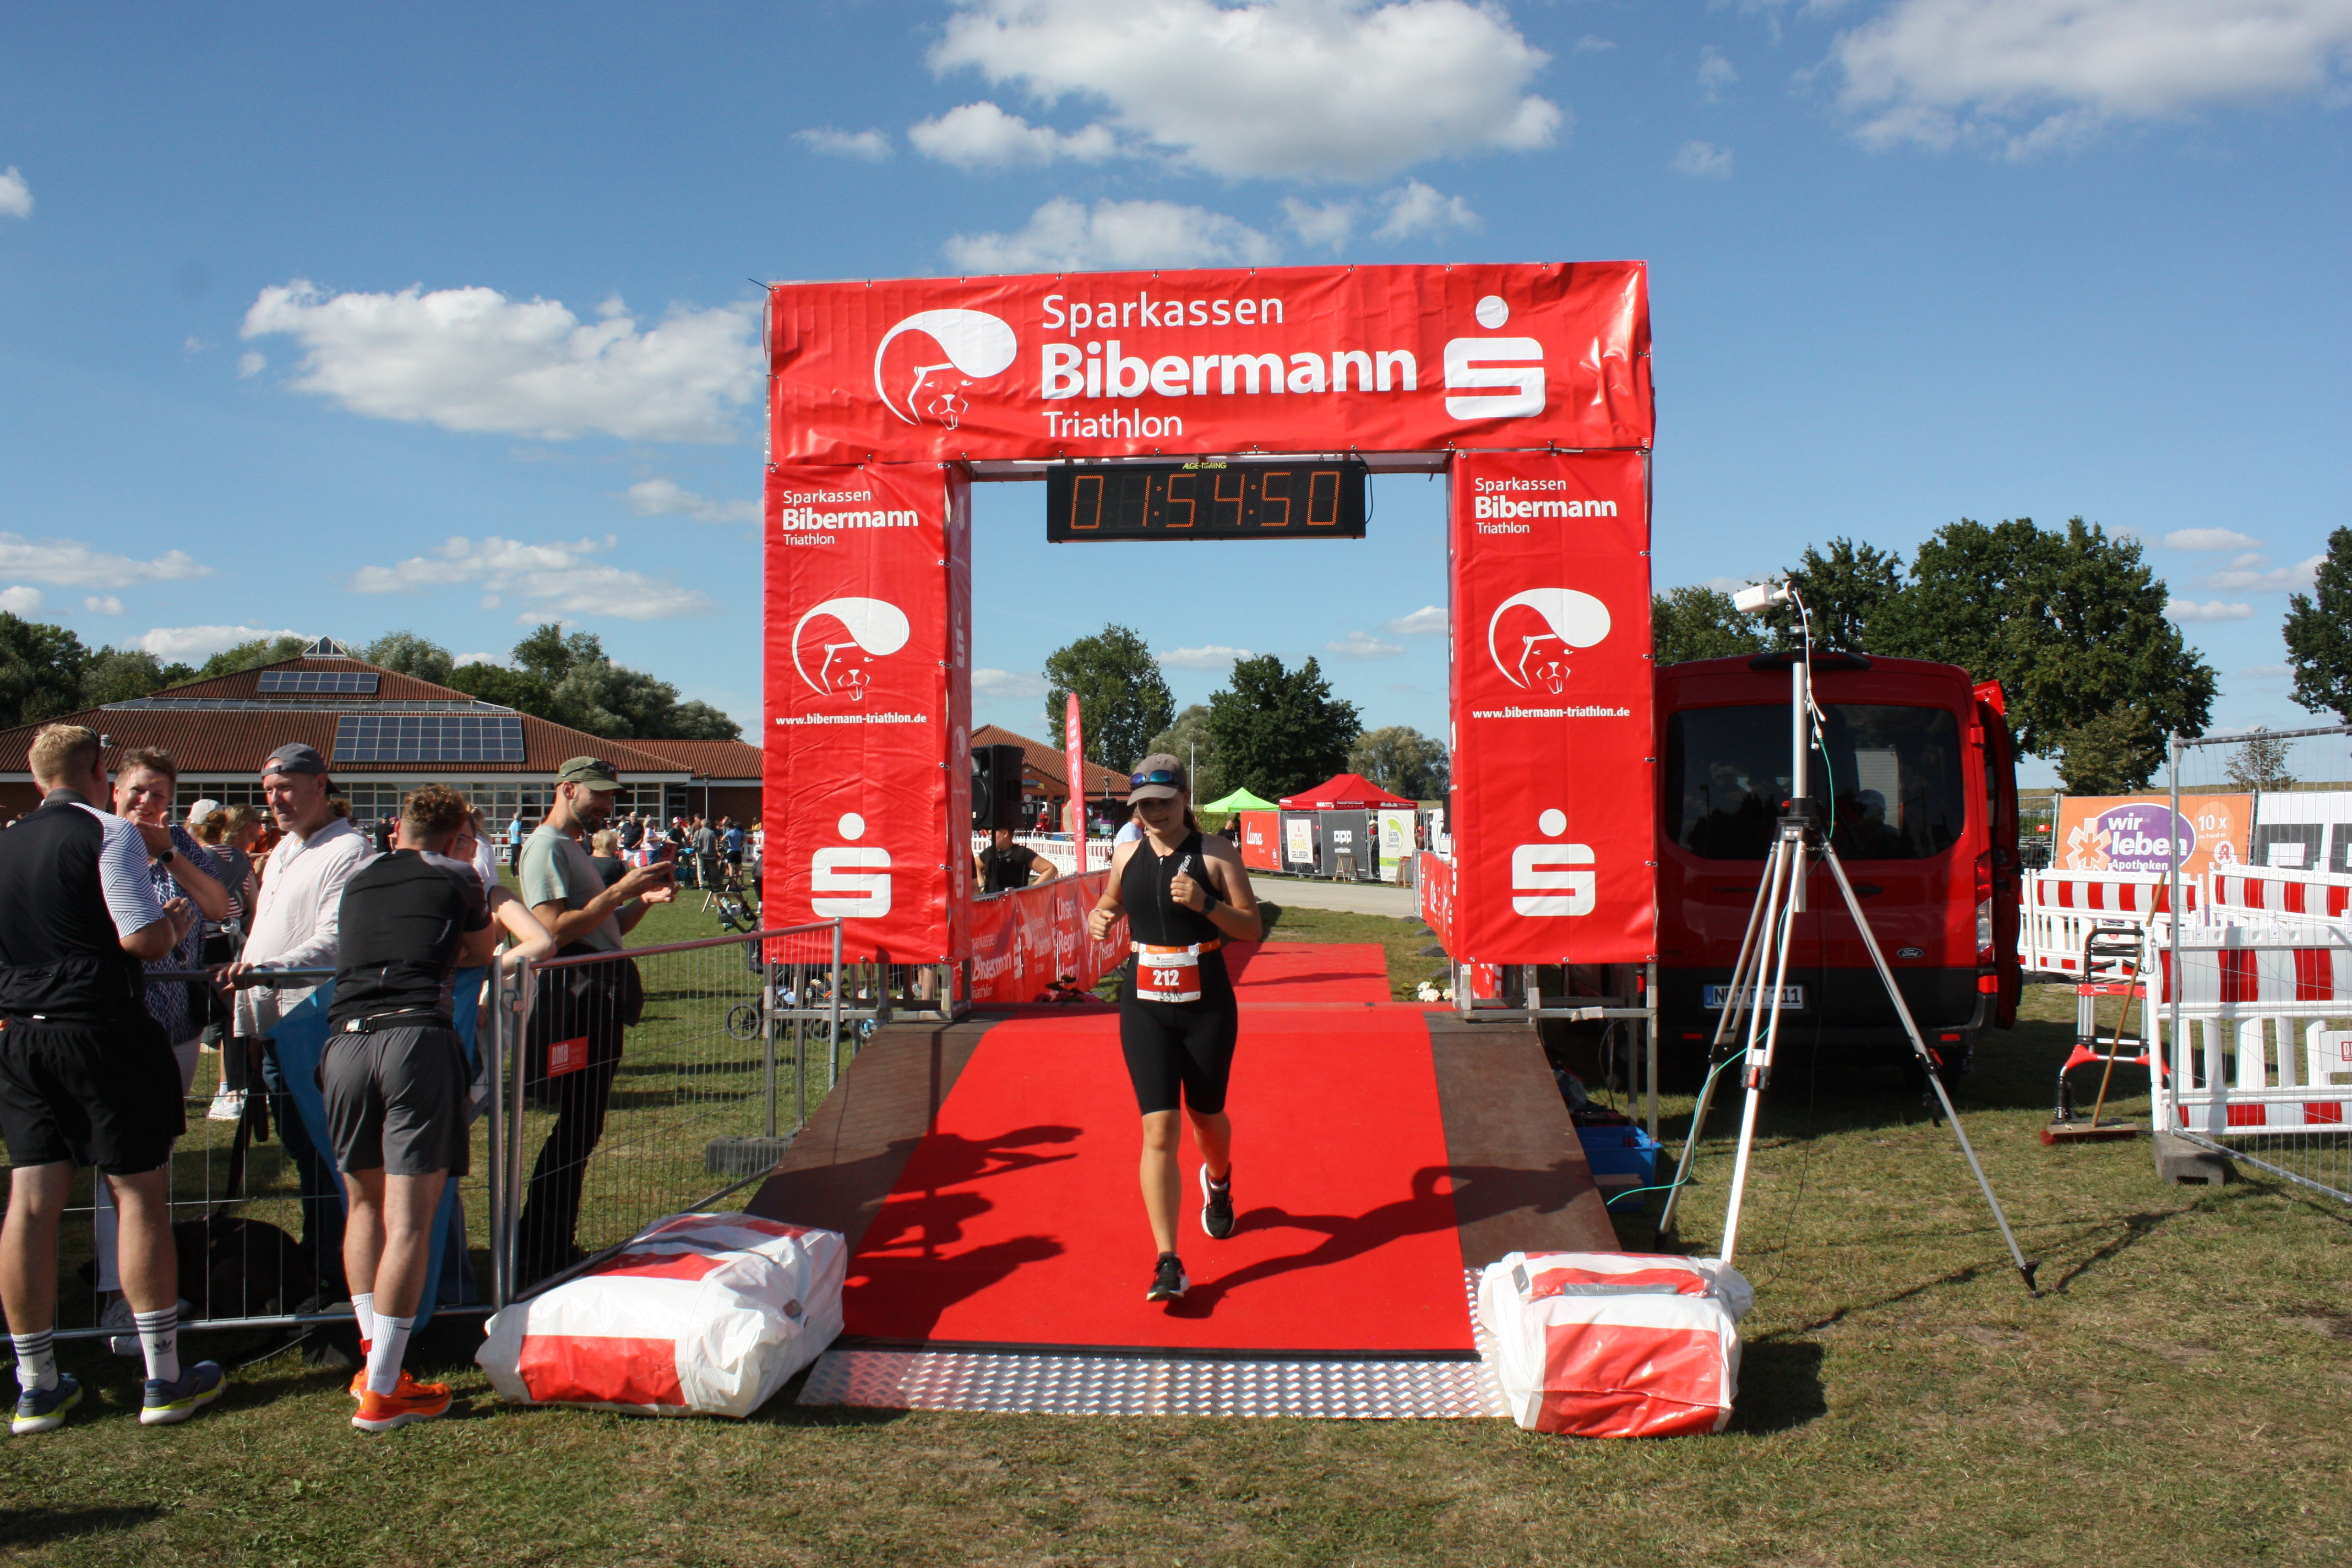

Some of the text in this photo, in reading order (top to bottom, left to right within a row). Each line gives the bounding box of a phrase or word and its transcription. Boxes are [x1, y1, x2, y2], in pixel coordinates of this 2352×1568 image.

[1042, 292, 1284, 336] Sparkassen
[1039, 340, 1417, 400] Bibermann
[1042, 409, 1183, 438] Triathlon
[1475, 477, 1566, 494] Sparkassen
[783, 489, 871, 507] Sparkassen
[1475, 495, 1617, 519] Bibermann
[783, 508, 918, 530] Bibermann
[1476, 522, 1530, 534] Triathlon
[783, 533, 835, 545] Triathlon
[776, 712, 927, 725] www.bibermann-triathlon.de
[1473, 706, 1630, 718] www.bibermann-triathlon.de
[2108, 813, 2143, 830] wir
[2198, 815, 2228, 831] 10 x
[1246, 821, 1263, 845] Luna
[2111, 831, 2187, 856] leben
[2112, 859, 2168, 870] Apotheken
[1902, 949, 1919, 957] Ford
[1153, 970, 1179, 986] 212
